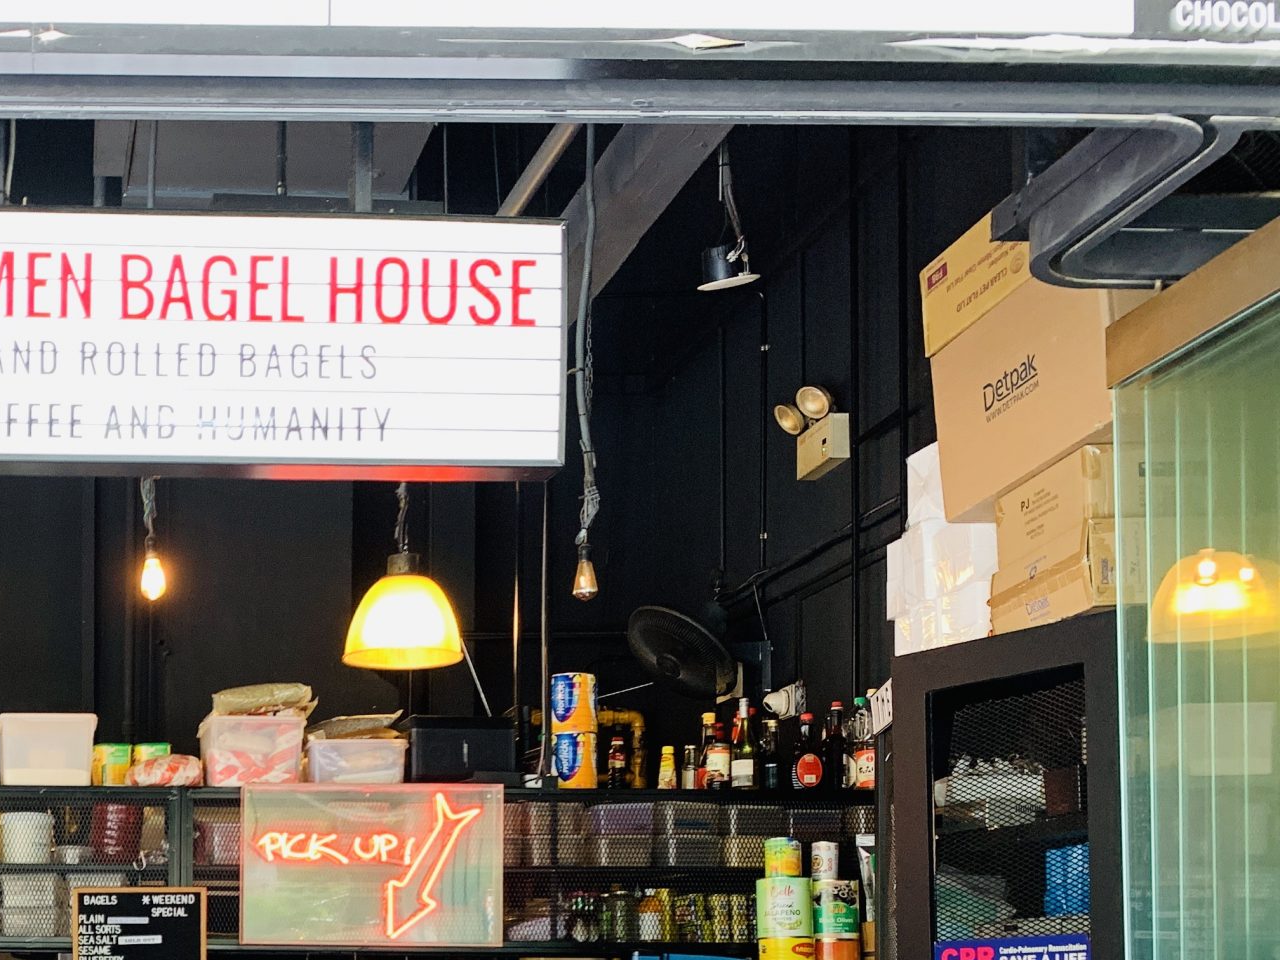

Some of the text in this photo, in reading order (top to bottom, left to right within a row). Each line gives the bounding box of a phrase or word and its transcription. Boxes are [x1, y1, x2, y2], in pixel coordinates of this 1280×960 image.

[119, 254, 305, 323] BAGEL
[328, 256, 538, 328] HOUSE
[80, 341, 218, 379] ROLLED
[240, 344, 379, 381] BAGELS
[983, 353, 1038, 412] Detpak
[197, 404, 393, 443] HUMANITY
[556, 680, 566, 715] Horlicks
[256, 831, 350, 864] PICK
[83, 894, 195, 906] BAGELS WEEKEND
[78, 914, 105, 925] PLAIN
[151, 907, 188, 918] SPECIAL
[78, 924, 121, 935] ALL SORTS
[78, 934, 117, 945] SEA SALT
[78, 945, 111, 956] SESAME
